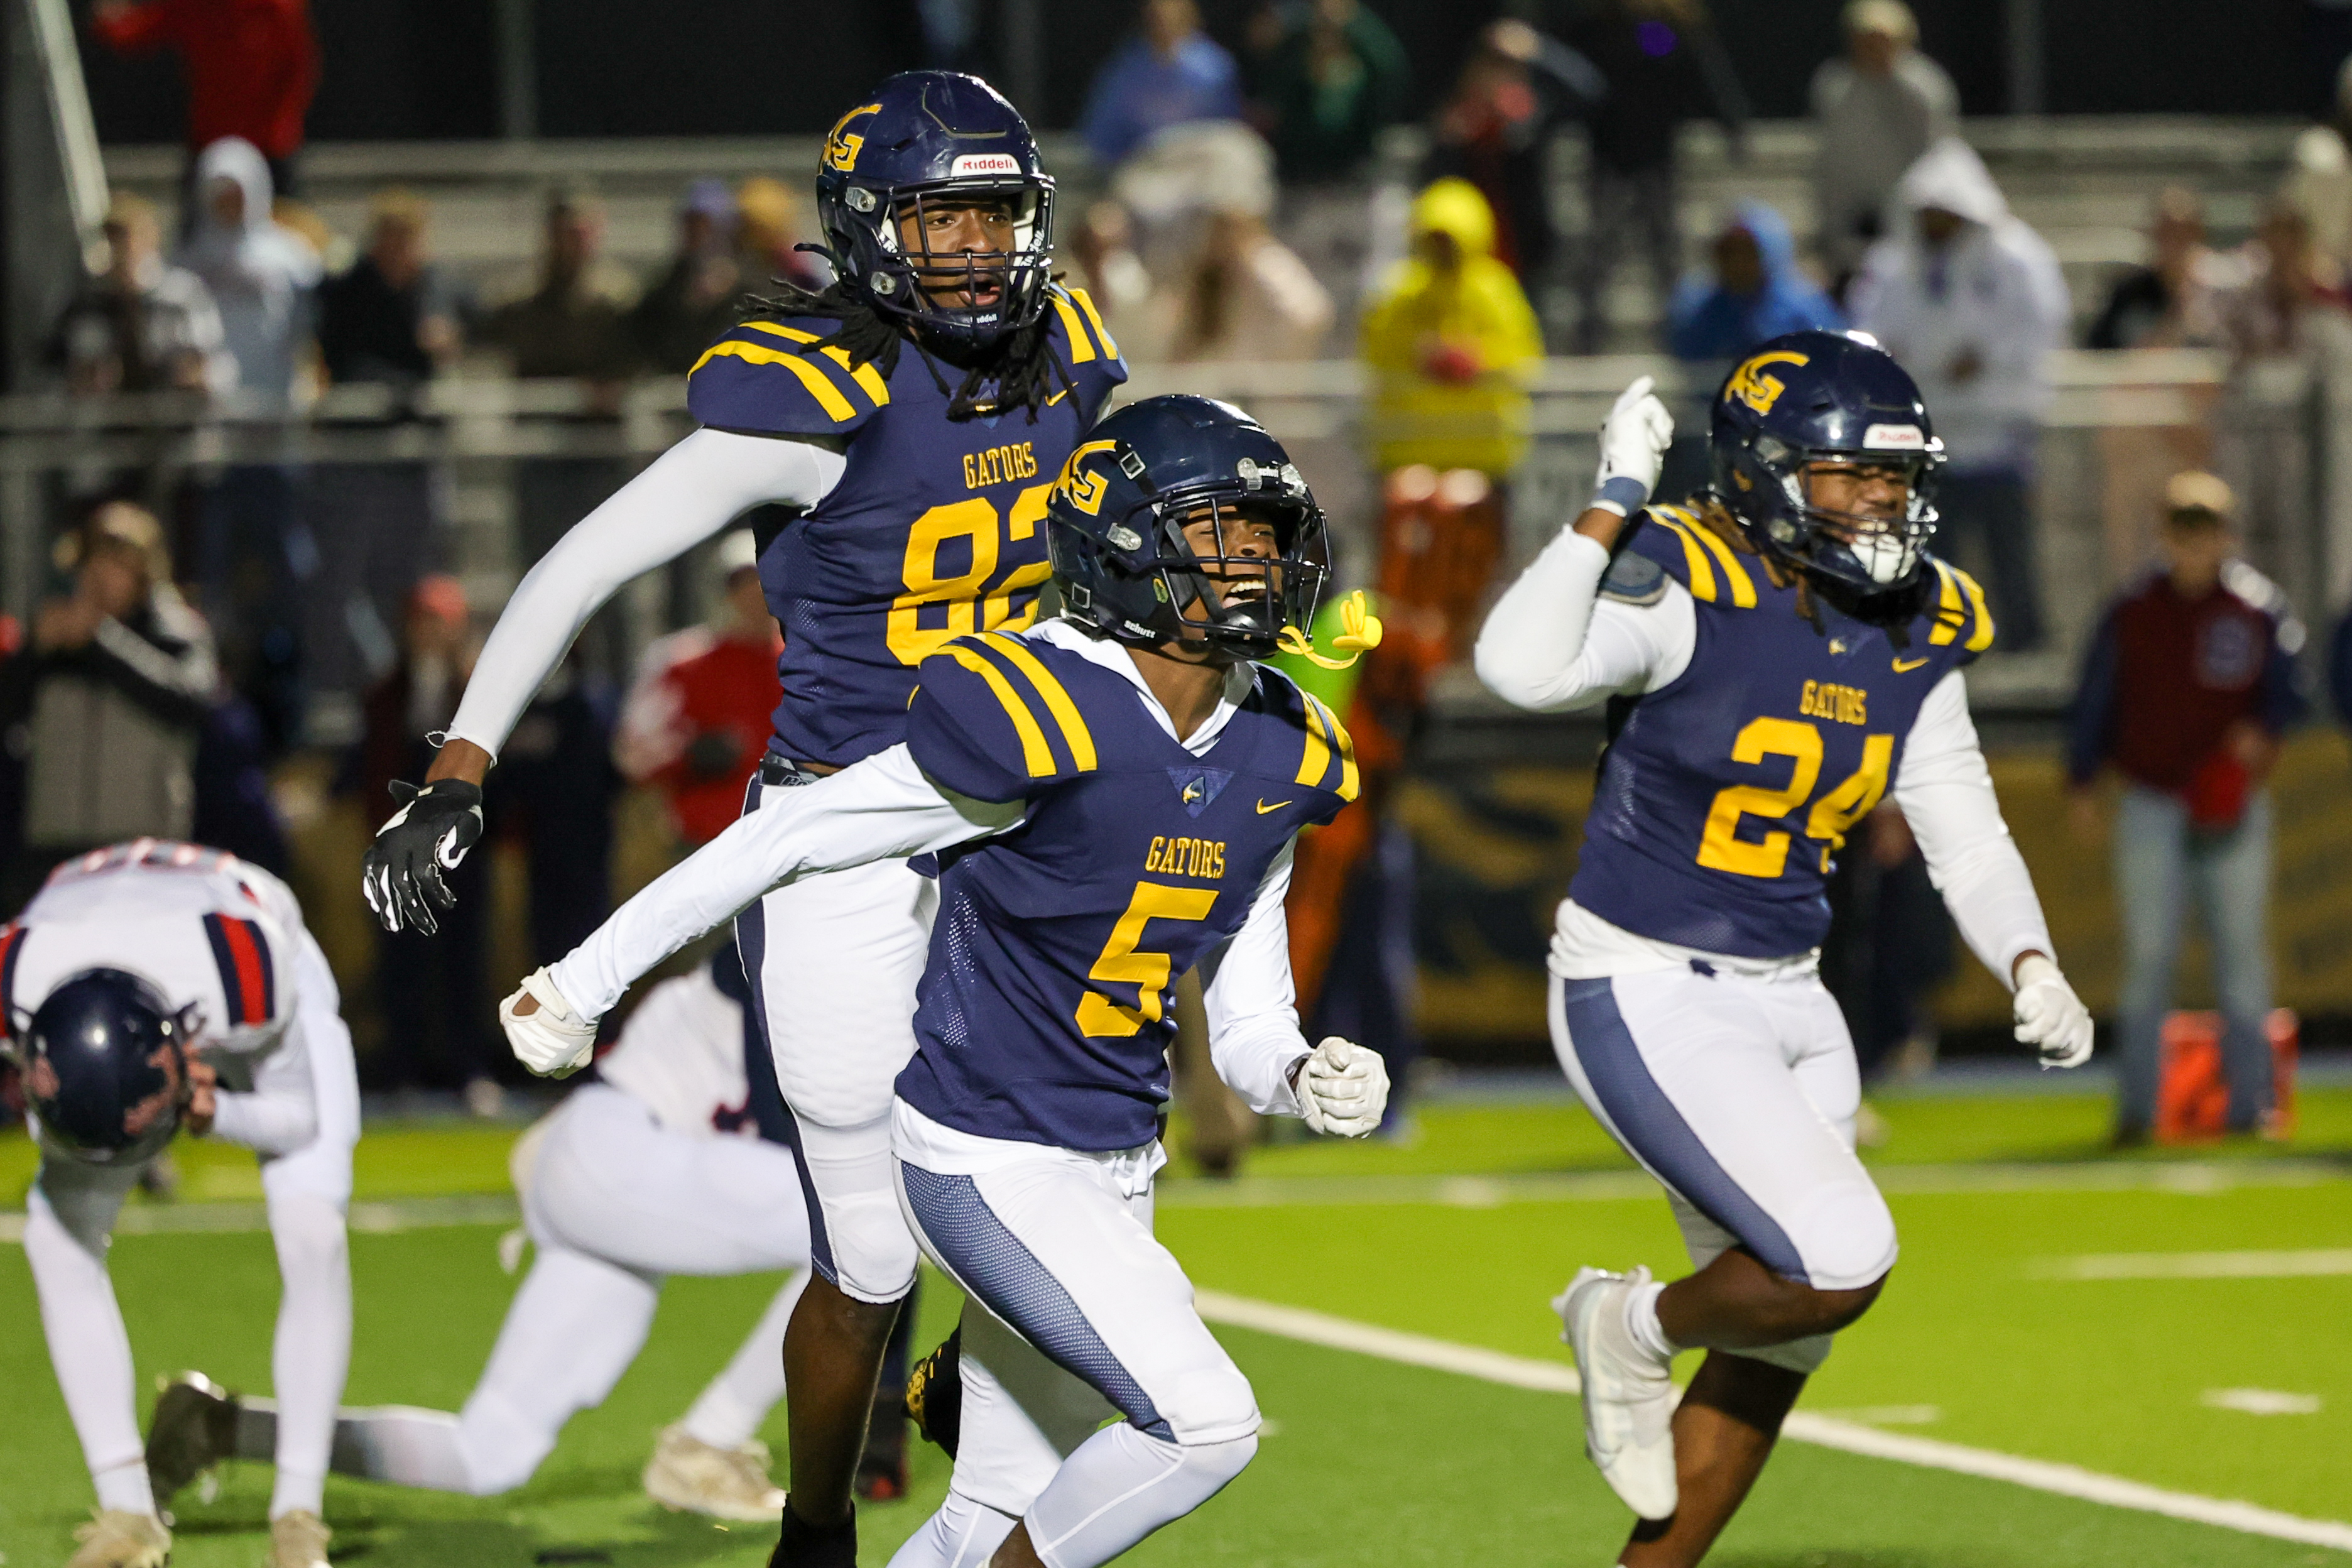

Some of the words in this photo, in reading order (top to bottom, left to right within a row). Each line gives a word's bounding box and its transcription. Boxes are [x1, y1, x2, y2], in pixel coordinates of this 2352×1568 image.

[963, 441, 1038, 489] GATORS
[1123, 619, 1156, 638] schutt
[1799, 679, 1867, 726] GATORS
[1697, 716, 1894, 878] 24
[1145, 836, 1226, 879] GATORS
[1075, 881, 1219, 1038] 5
